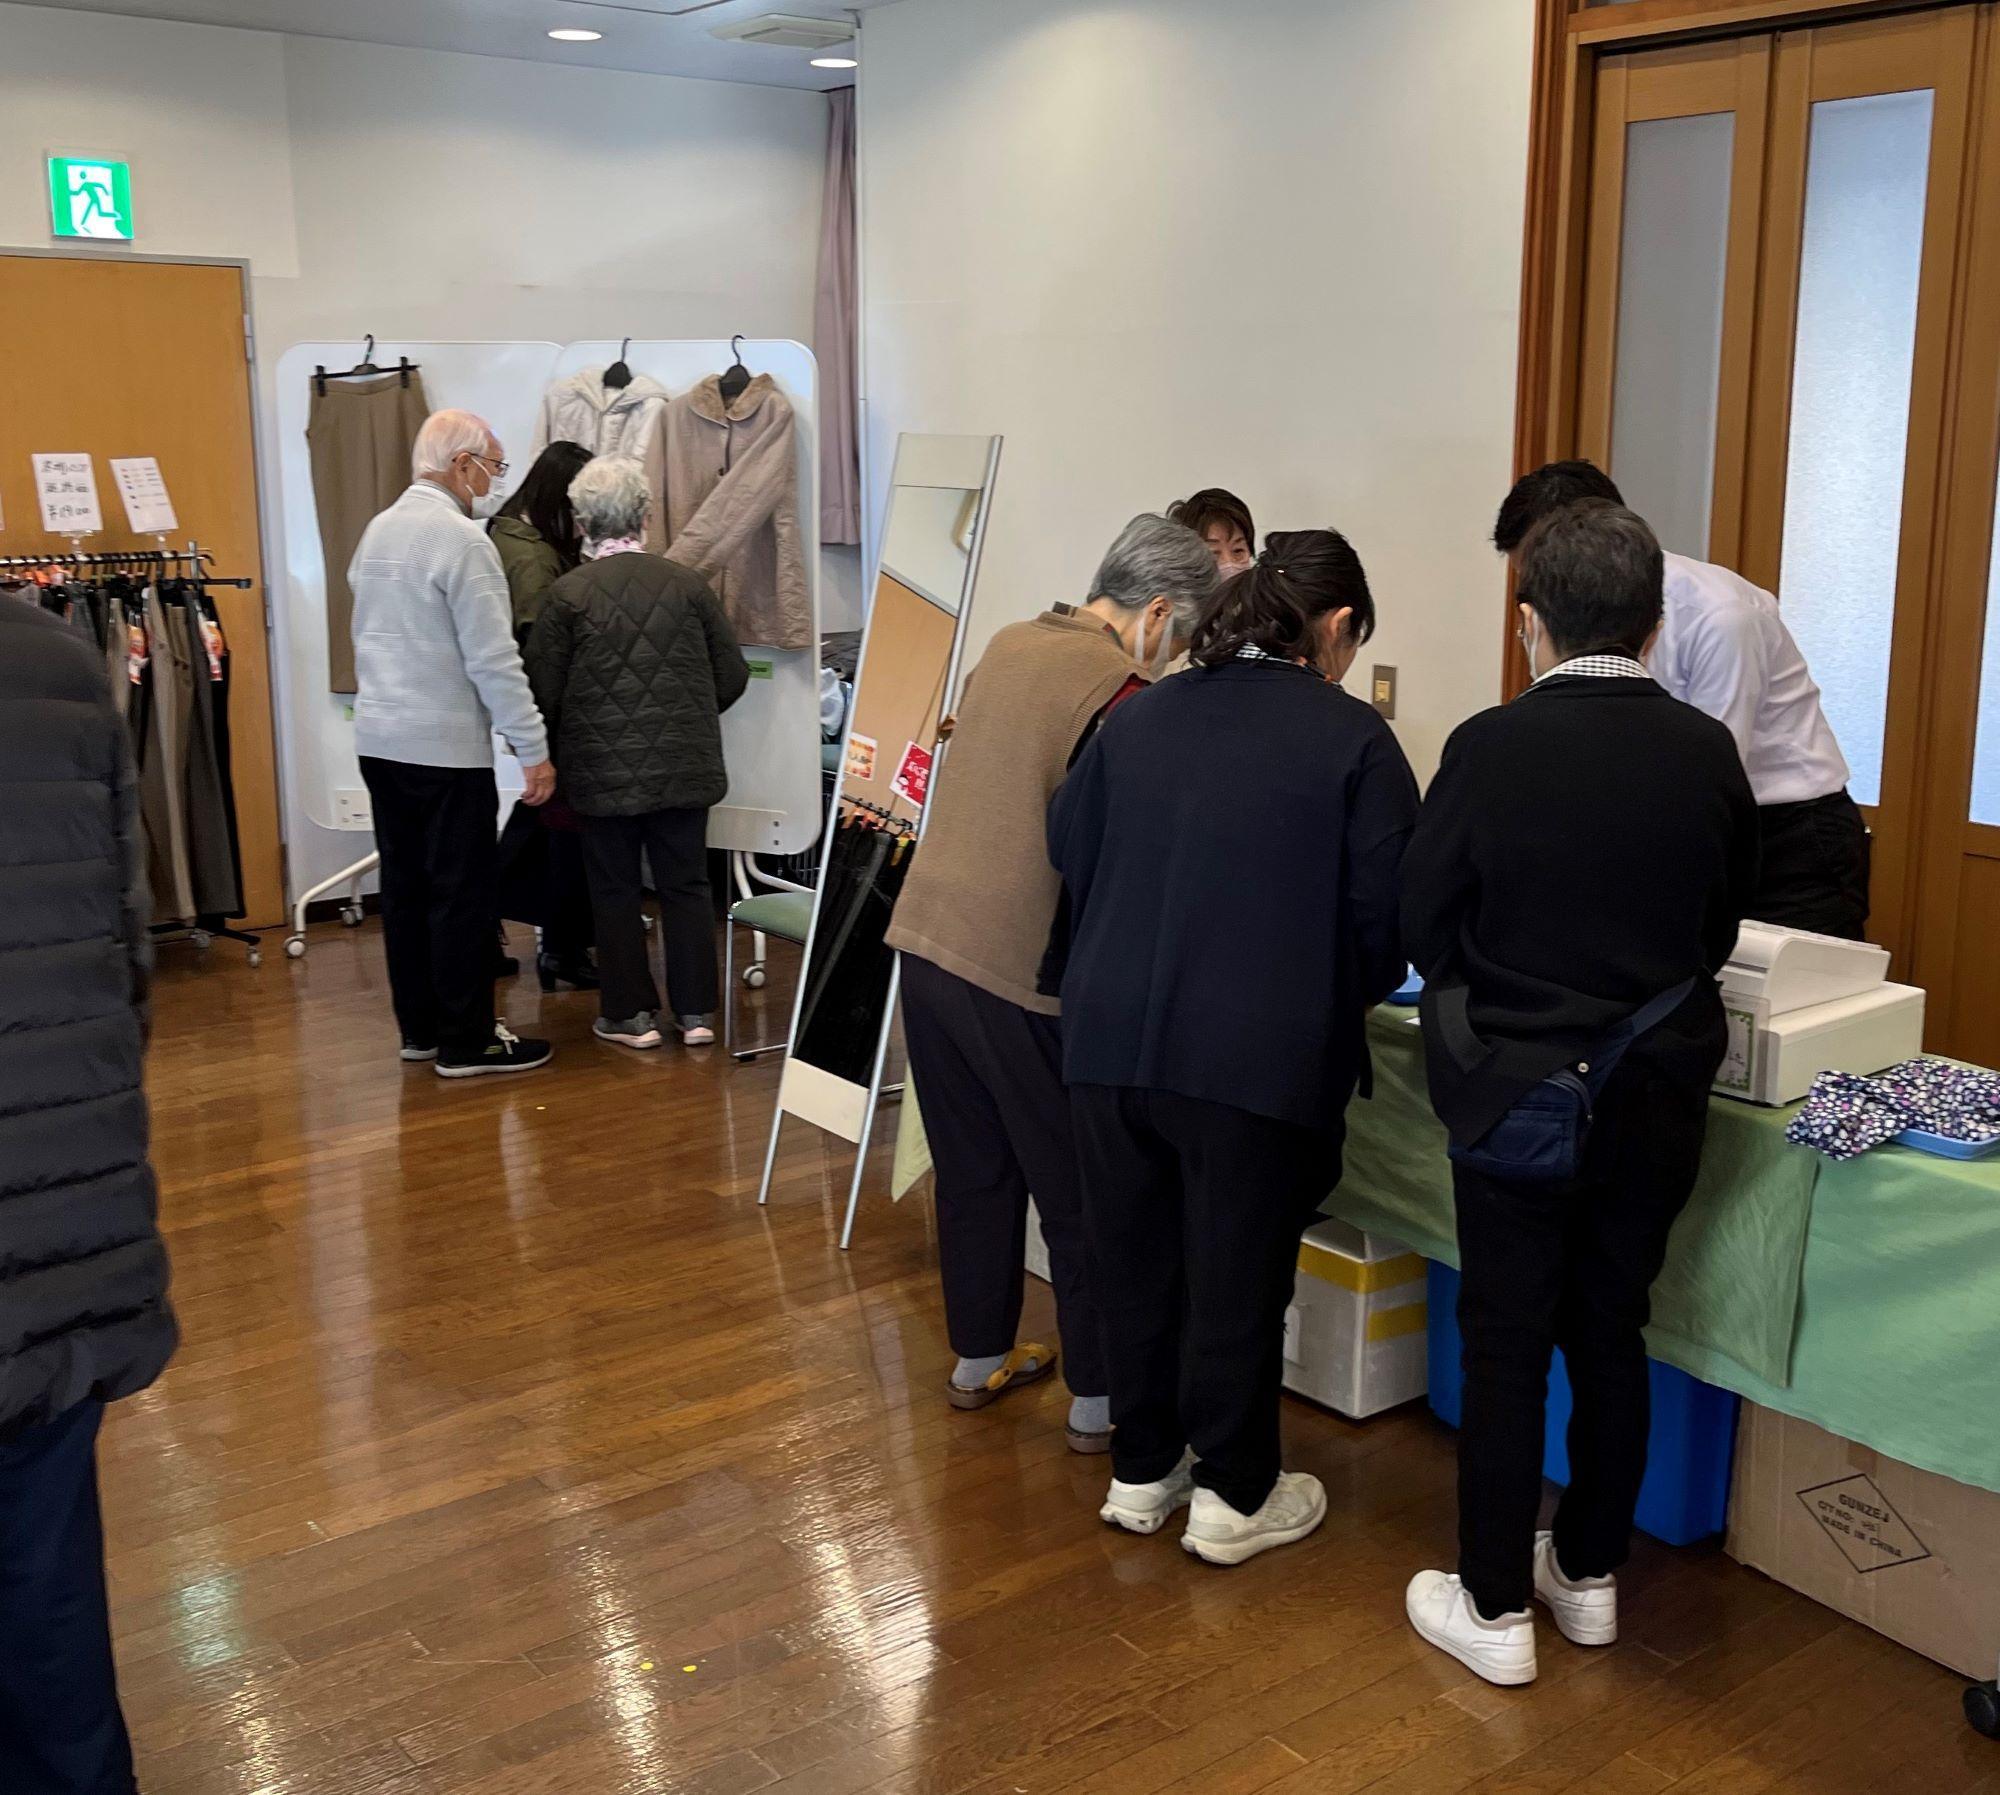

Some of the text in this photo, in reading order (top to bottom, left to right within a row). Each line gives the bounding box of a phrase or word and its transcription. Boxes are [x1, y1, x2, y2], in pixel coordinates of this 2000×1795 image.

[1820, 1515, 1850, 1535] MADE
[1854, 1530, 1867, 1542] IN
[1869, 1537, 1903, 1558] CHINA
